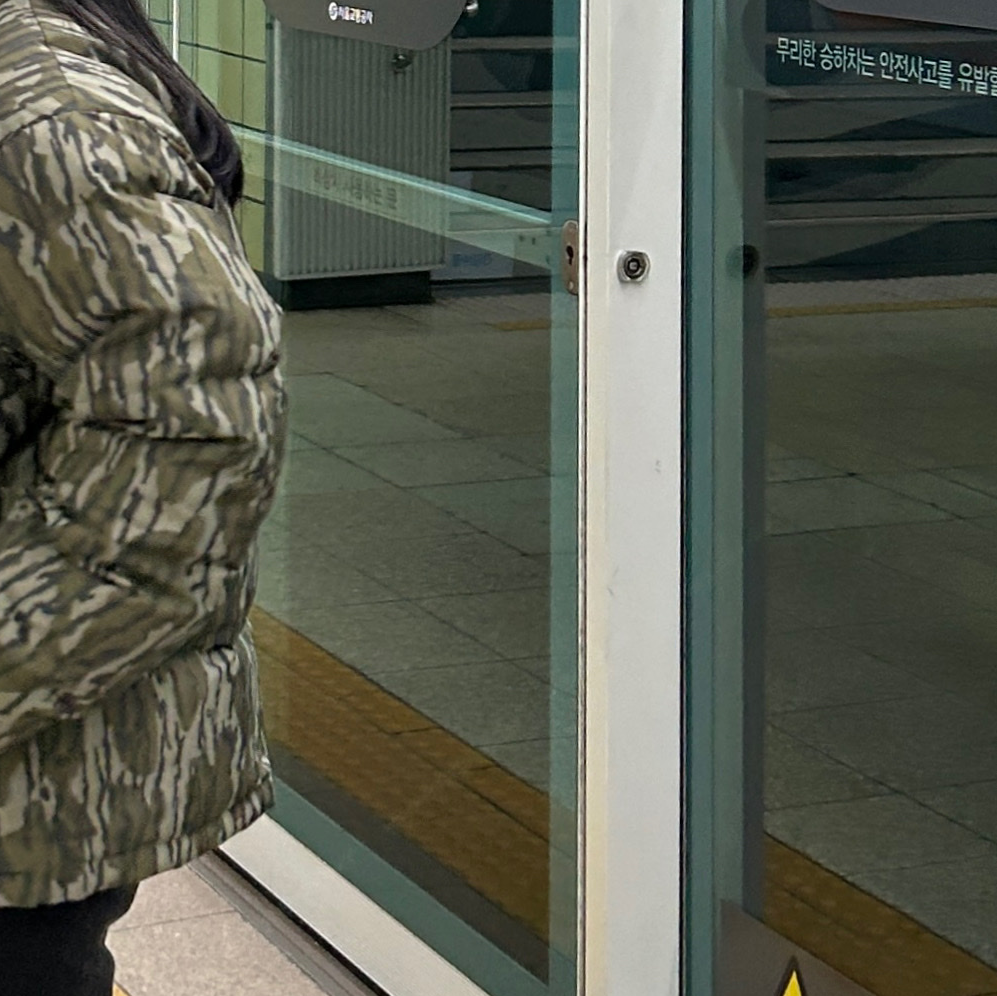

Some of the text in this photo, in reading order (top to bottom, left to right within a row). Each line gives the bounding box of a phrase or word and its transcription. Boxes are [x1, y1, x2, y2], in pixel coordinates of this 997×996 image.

[776, 37, 816, 68] 무리한
[819, 43, 876, 77] 승하차는
[879, 51, 954, 90] 안전사고를
